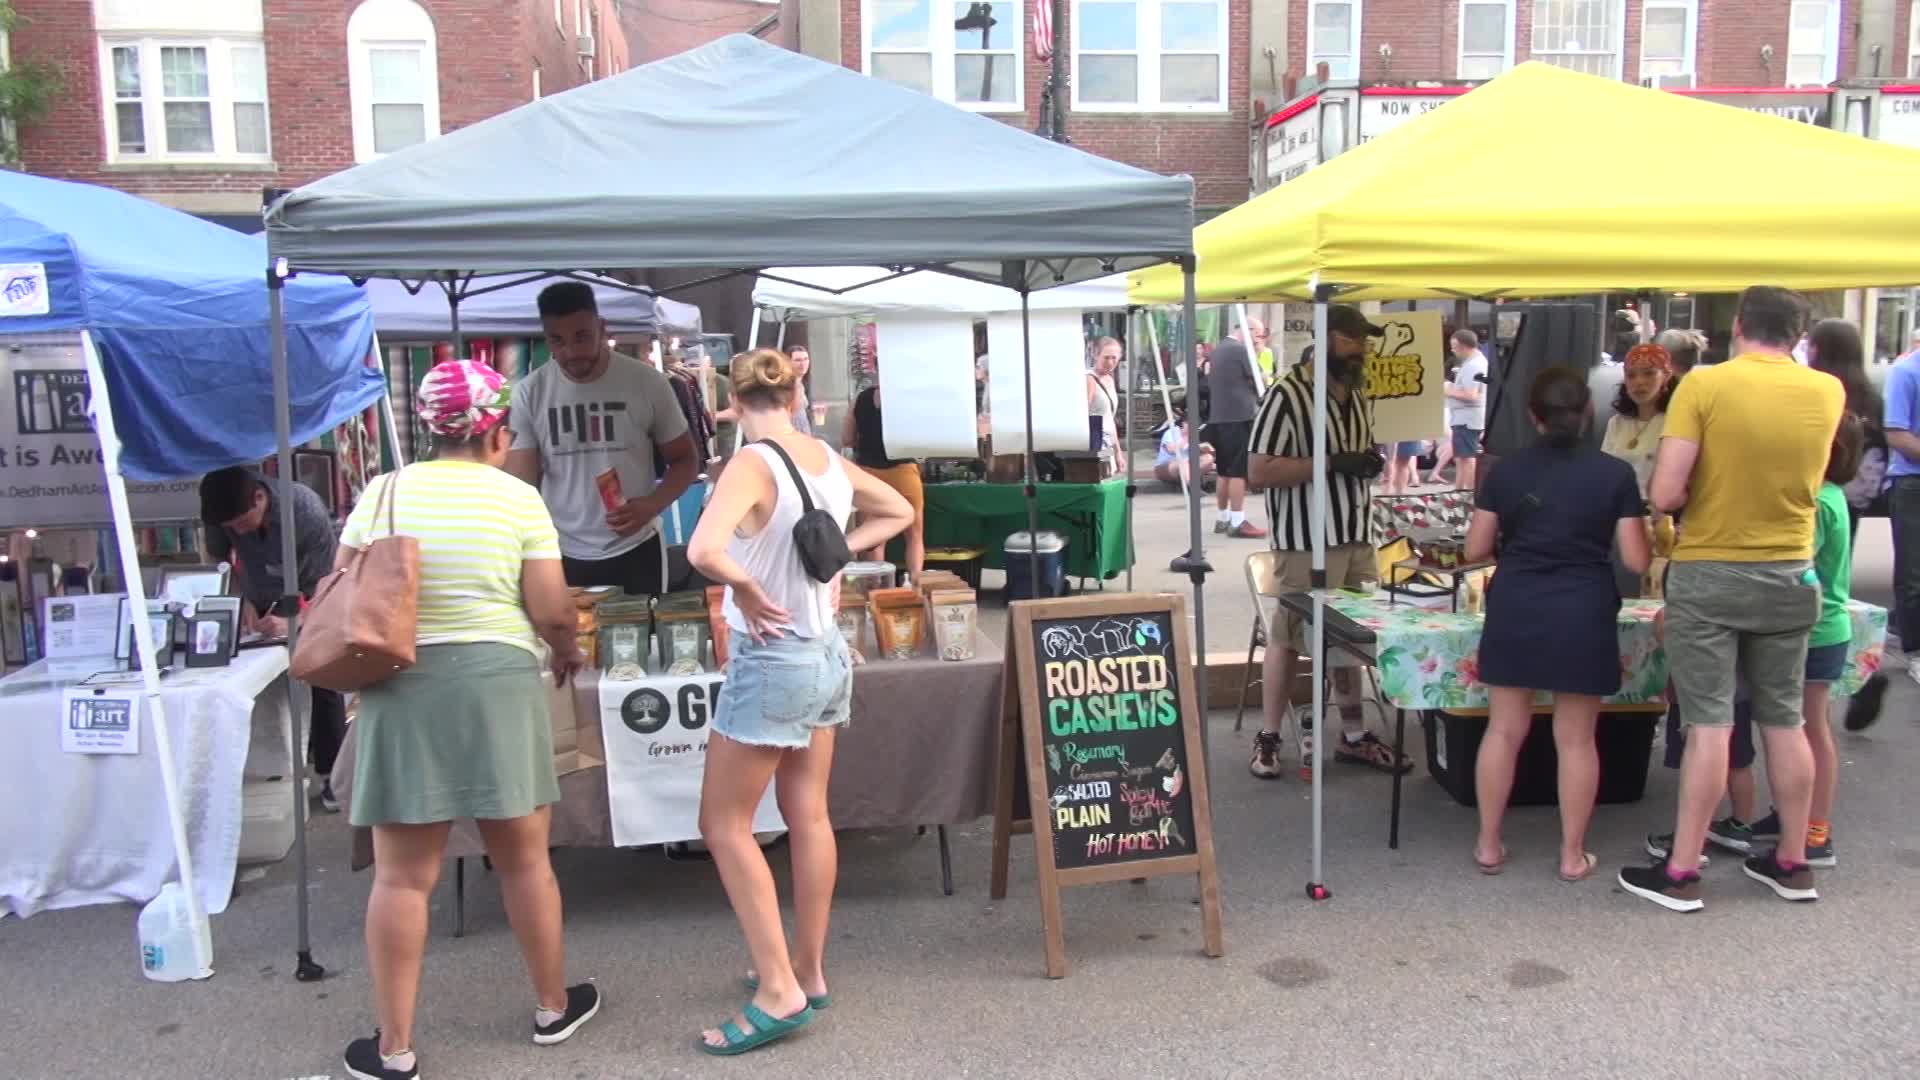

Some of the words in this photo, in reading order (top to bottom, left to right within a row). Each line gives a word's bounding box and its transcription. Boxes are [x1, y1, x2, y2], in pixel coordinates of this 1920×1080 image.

[1380, 101, 1410, 115] NOW
[16, 446, 41, 467] is
[1045, 655, 1168, 698] ROASTED
[1049, 690, 1177, 736] CASHEWS
[1067, 781, 1111, 801] SALTED
[1057, 803, 1111, 829] PLAIN
